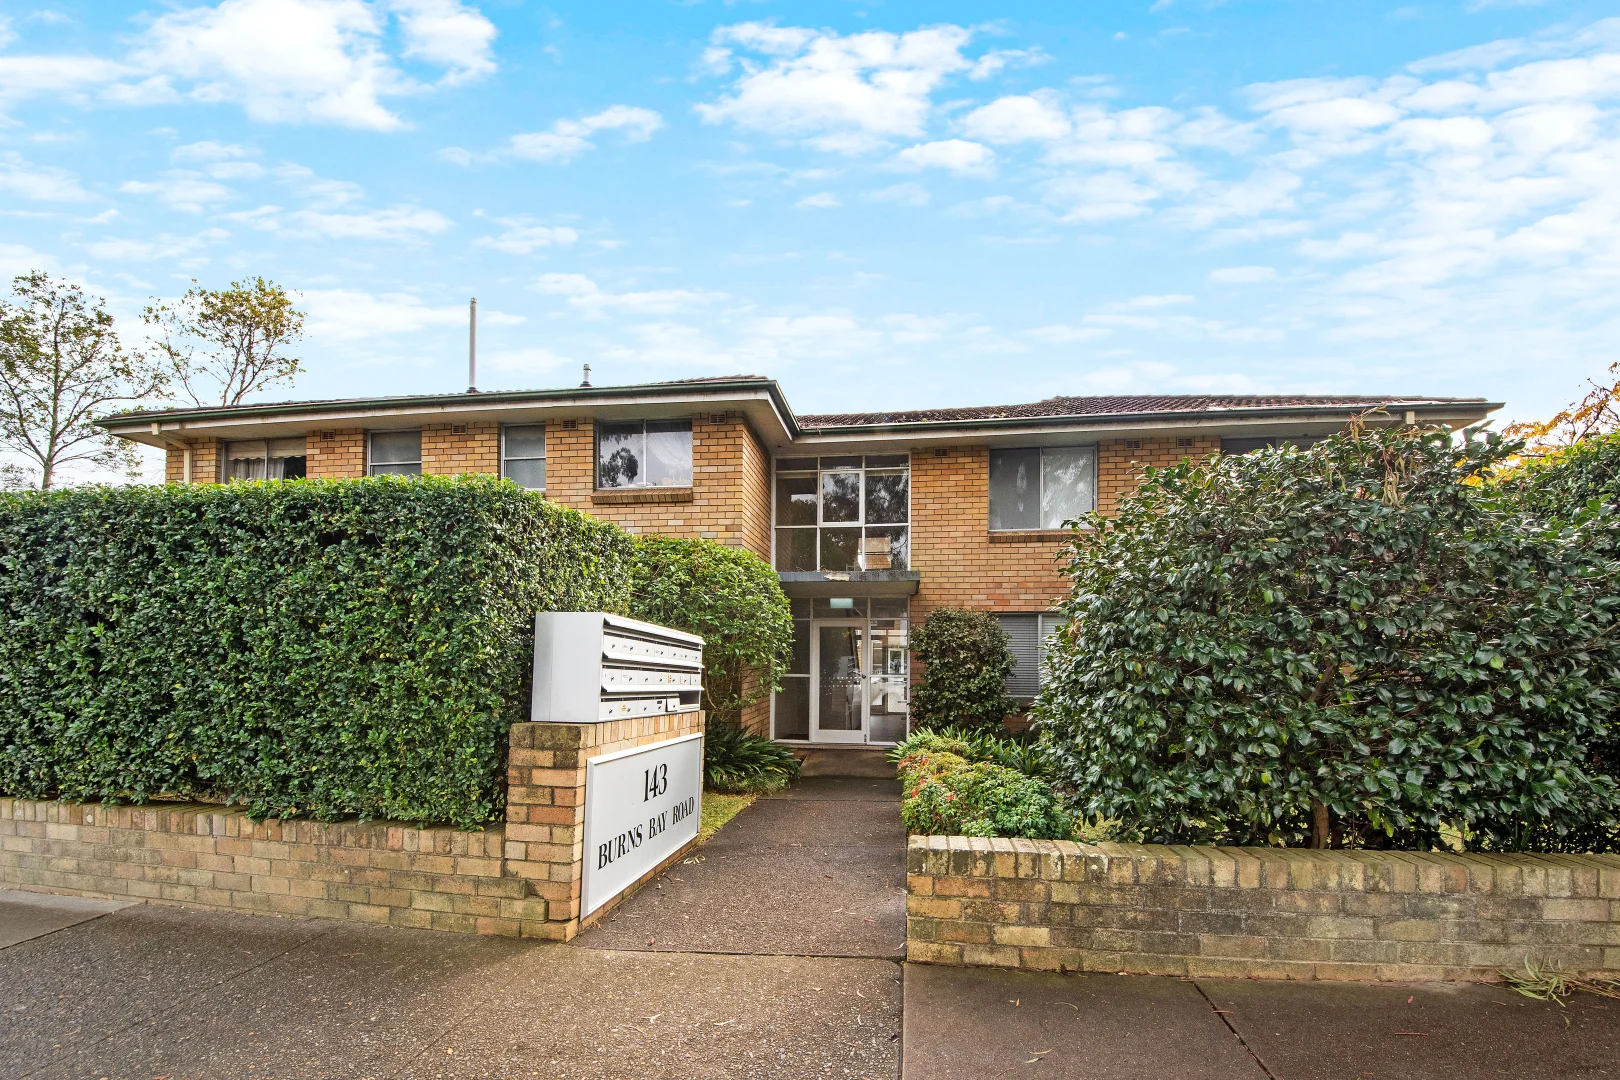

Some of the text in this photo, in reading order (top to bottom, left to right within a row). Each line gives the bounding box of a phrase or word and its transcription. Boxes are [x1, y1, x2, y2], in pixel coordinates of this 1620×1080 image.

[643, 763, 668, 802] 143
[597, 796, 695, 870] BURNS BAY ROAD
